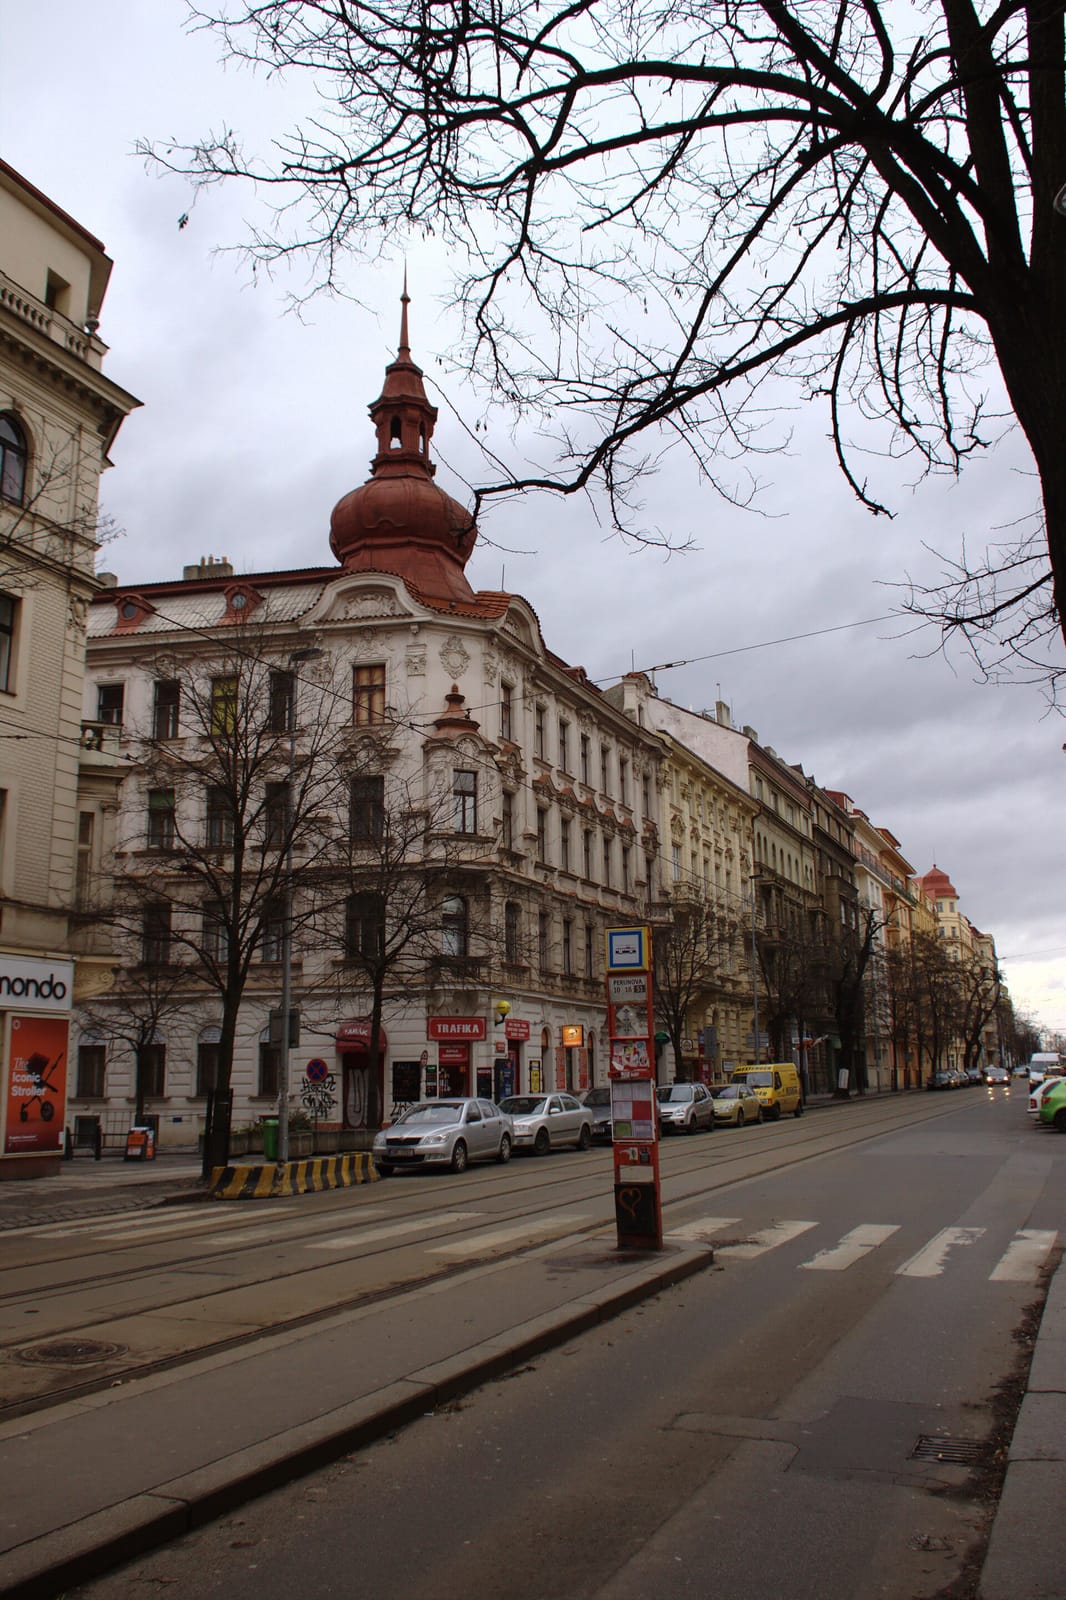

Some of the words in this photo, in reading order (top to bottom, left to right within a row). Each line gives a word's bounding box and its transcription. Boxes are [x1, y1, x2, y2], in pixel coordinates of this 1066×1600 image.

[613, 978, 643, 986] PERUNOVA
[436, 1023, 479, 1033] TRAFIKA
[12, 1071, 41, 1082] Iconic
[11, 1085, 47, 1097] Stroller
